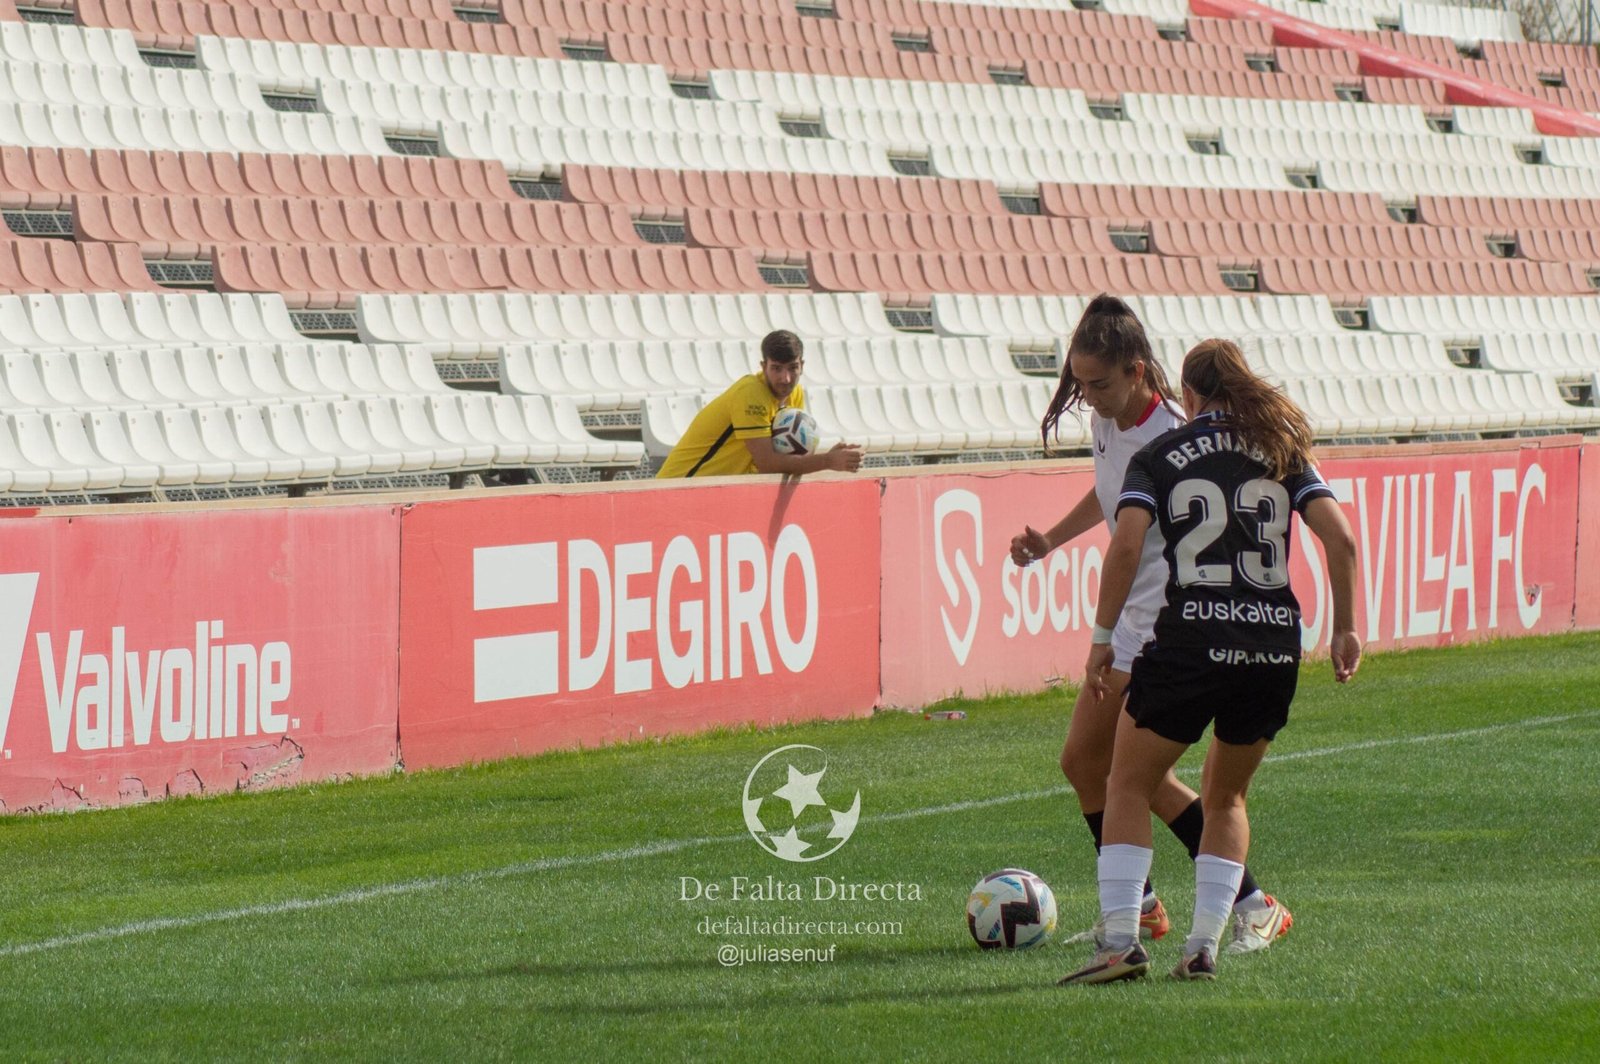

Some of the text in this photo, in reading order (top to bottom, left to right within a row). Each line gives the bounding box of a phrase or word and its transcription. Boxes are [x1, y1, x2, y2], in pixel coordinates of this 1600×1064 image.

[568, 523, 819, 695] DEGIRO
[1168, 478, 1290, 589] 23
[1298, 463, 1547, 652] SVILLA FC
[36, 620, 292, 753] Valvoline
